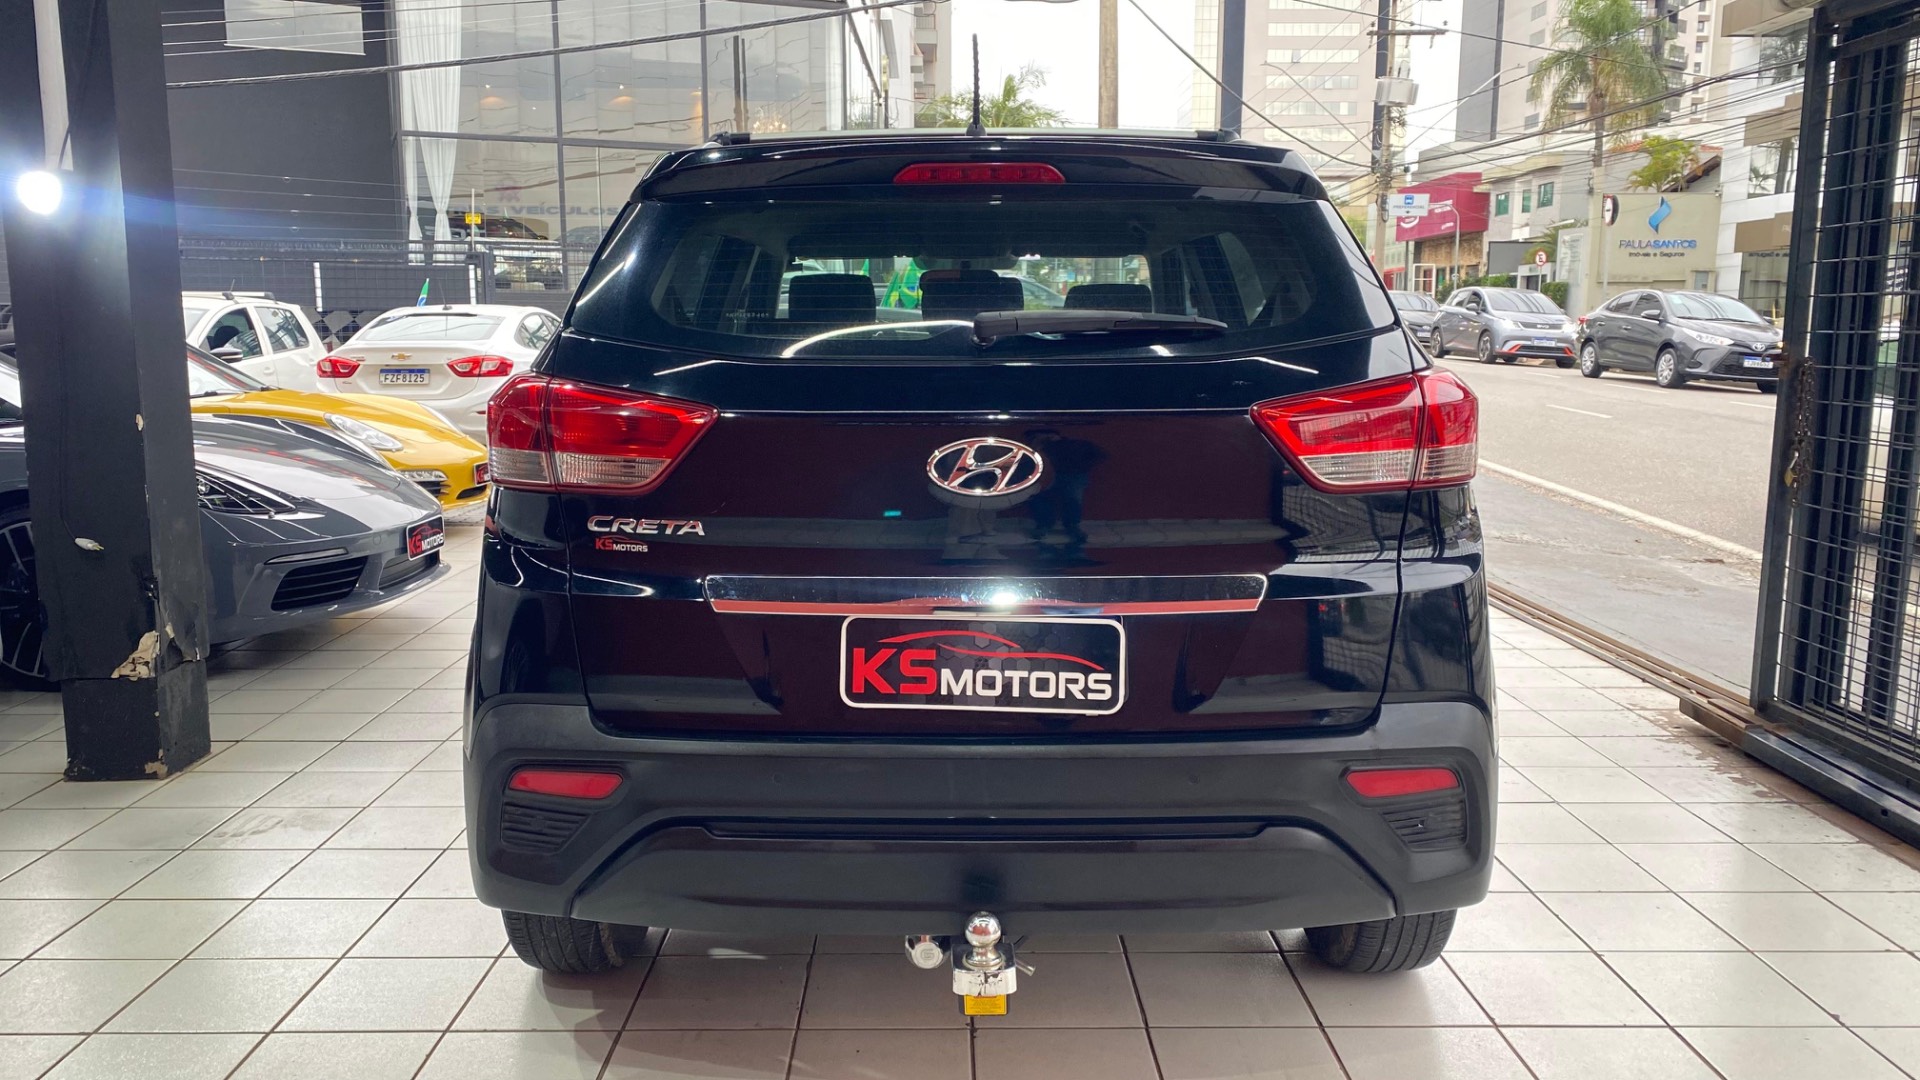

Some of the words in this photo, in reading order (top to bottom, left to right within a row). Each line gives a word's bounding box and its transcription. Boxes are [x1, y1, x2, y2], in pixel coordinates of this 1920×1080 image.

[512, 201, 619, 216] VEÍCULOS
[384, 373, 425, 383] FZF8I25
[586, 515, 706, 536] CRETA
[409, 534, 423, 555] KS
[422, 532, 444, 551] MOTORS
[595, 538, 613, 551] KS
[613, 543, 649, 552] MOTORS
[852, 647, 938, 695] KS
[940, 668, 1112, 701] MOTORS
